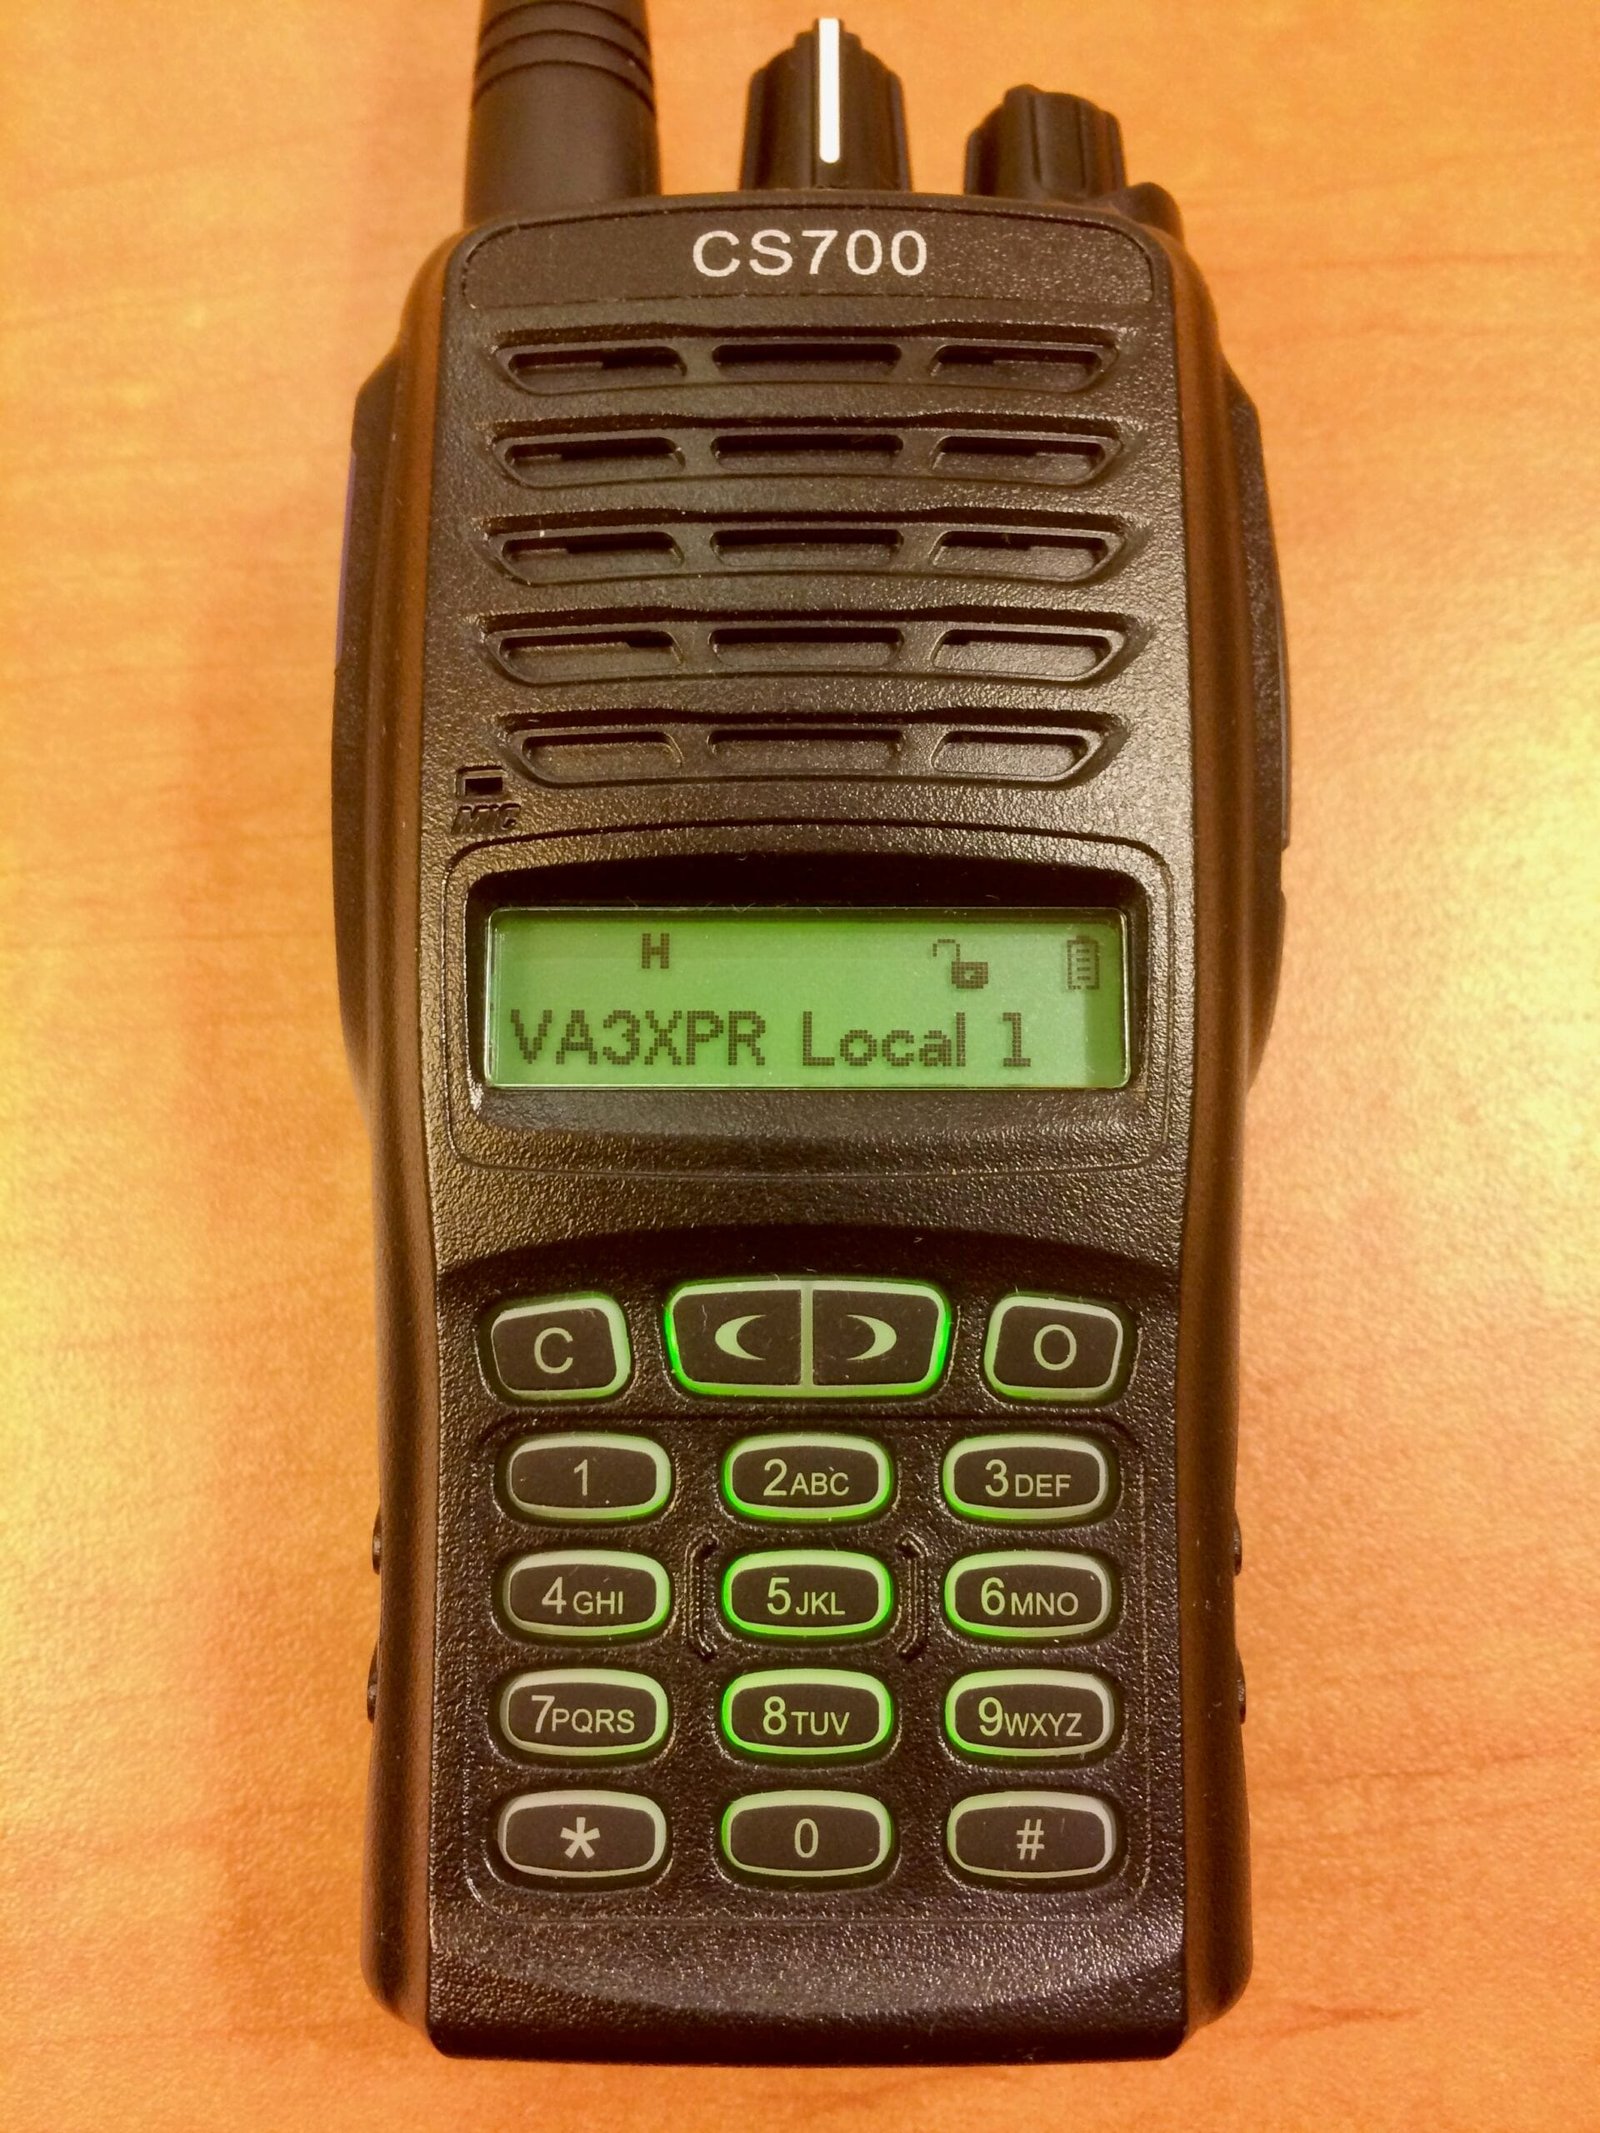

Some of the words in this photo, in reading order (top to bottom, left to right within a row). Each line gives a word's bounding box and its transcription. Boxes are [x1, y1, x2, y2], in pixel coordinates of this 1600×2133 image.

[692, 229, 928, 278] CS700
[641, 932, 671, 970] H
[509, 1008, 766, 1066] VA3XPR
[801, 1010, 967, 1068] Local
[1001, 1011, 1032, 1069] 1
[533, 1327, 574, 1374] C
[573, 1458, 588, 1497] 1
[794, 1818, 819, 1859] 0
